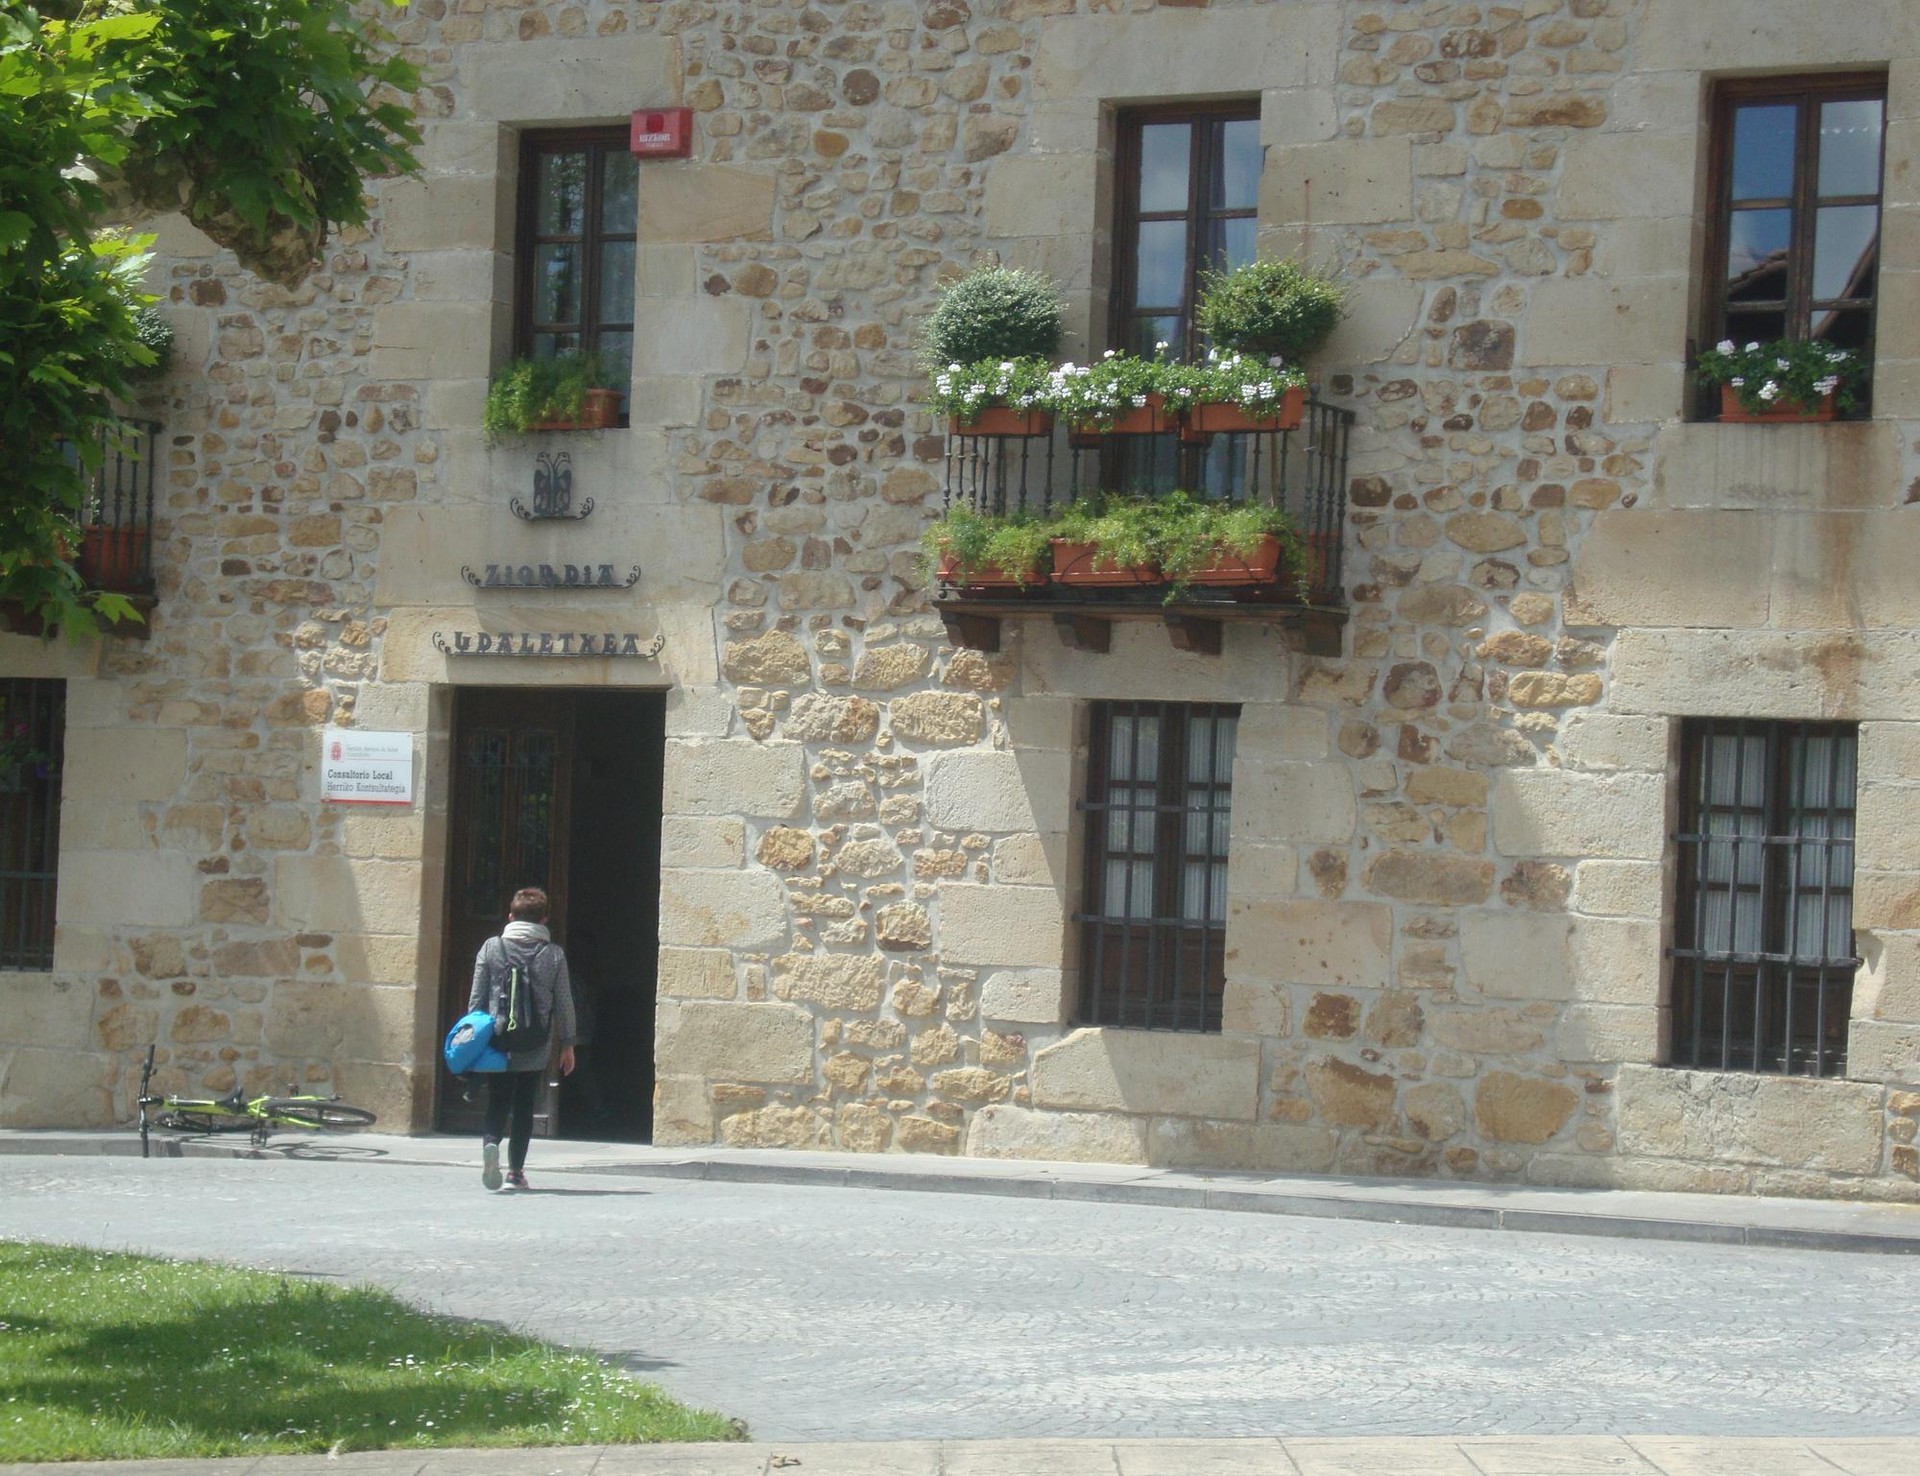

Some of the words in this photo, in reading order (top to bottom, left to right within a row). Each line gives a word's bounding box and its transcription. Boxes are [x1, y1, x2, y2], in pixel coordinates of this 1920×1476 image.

[454, 631, 639, 654] UDALETXEA
[327, 769, 370, 780] Consultorio
[372, 770, 393, 780] Local
[327, 781, 354, 792] Herriko
